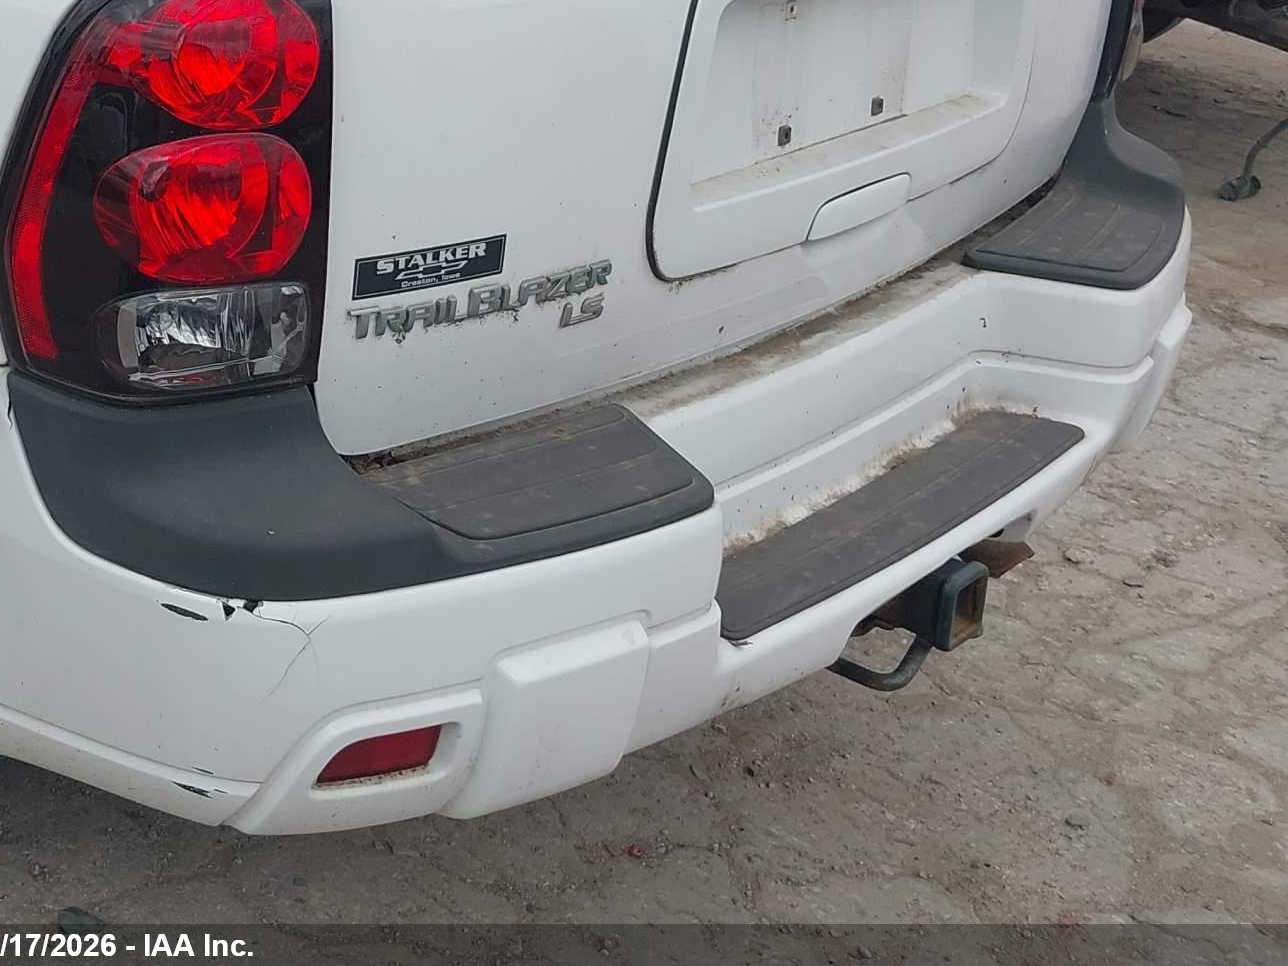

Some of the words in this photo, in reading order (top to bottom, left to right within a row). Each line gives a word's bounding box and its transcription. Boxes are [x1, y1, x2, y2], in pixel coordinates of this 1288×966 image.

[376, 242, 487, 275] STALKER
[400, 277, 439, 288] Creston,
[441, 272, 461, 282] Iowa
[346, 259, 612, 339] TRAILBLAZER
[559, 292, 605, 329] LS
